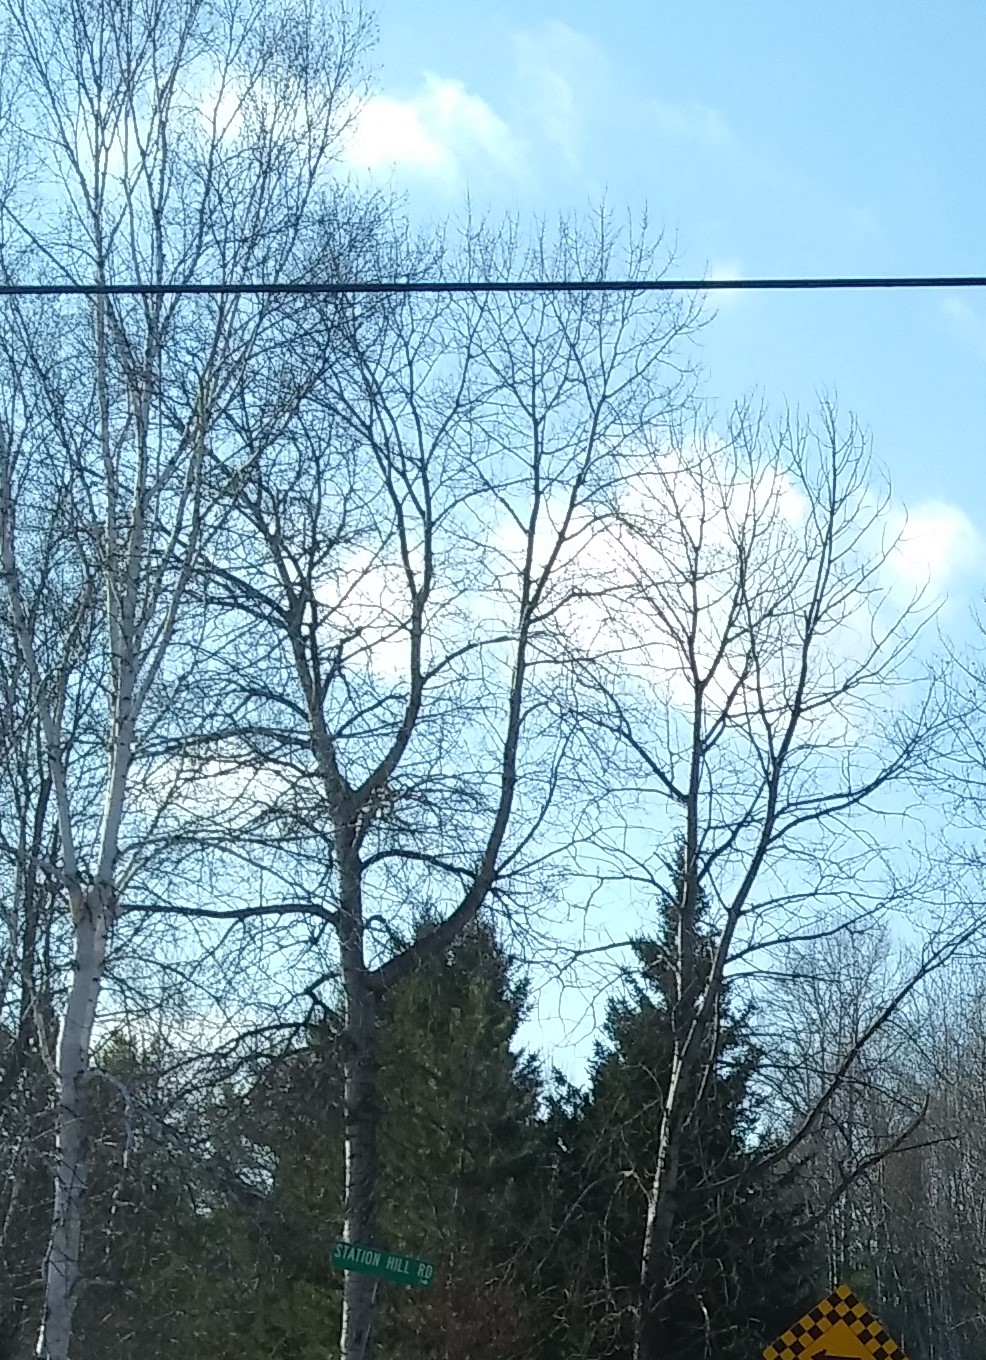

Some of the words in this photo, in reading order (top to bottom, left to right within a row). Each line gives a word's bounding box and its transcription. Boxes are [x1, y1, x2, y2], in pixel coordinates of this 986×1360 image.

[334, 1244, 381, 1267] STATION
[386, 1256, 409, 1274] HILL
[417, 1263, 433, 1279] RD
